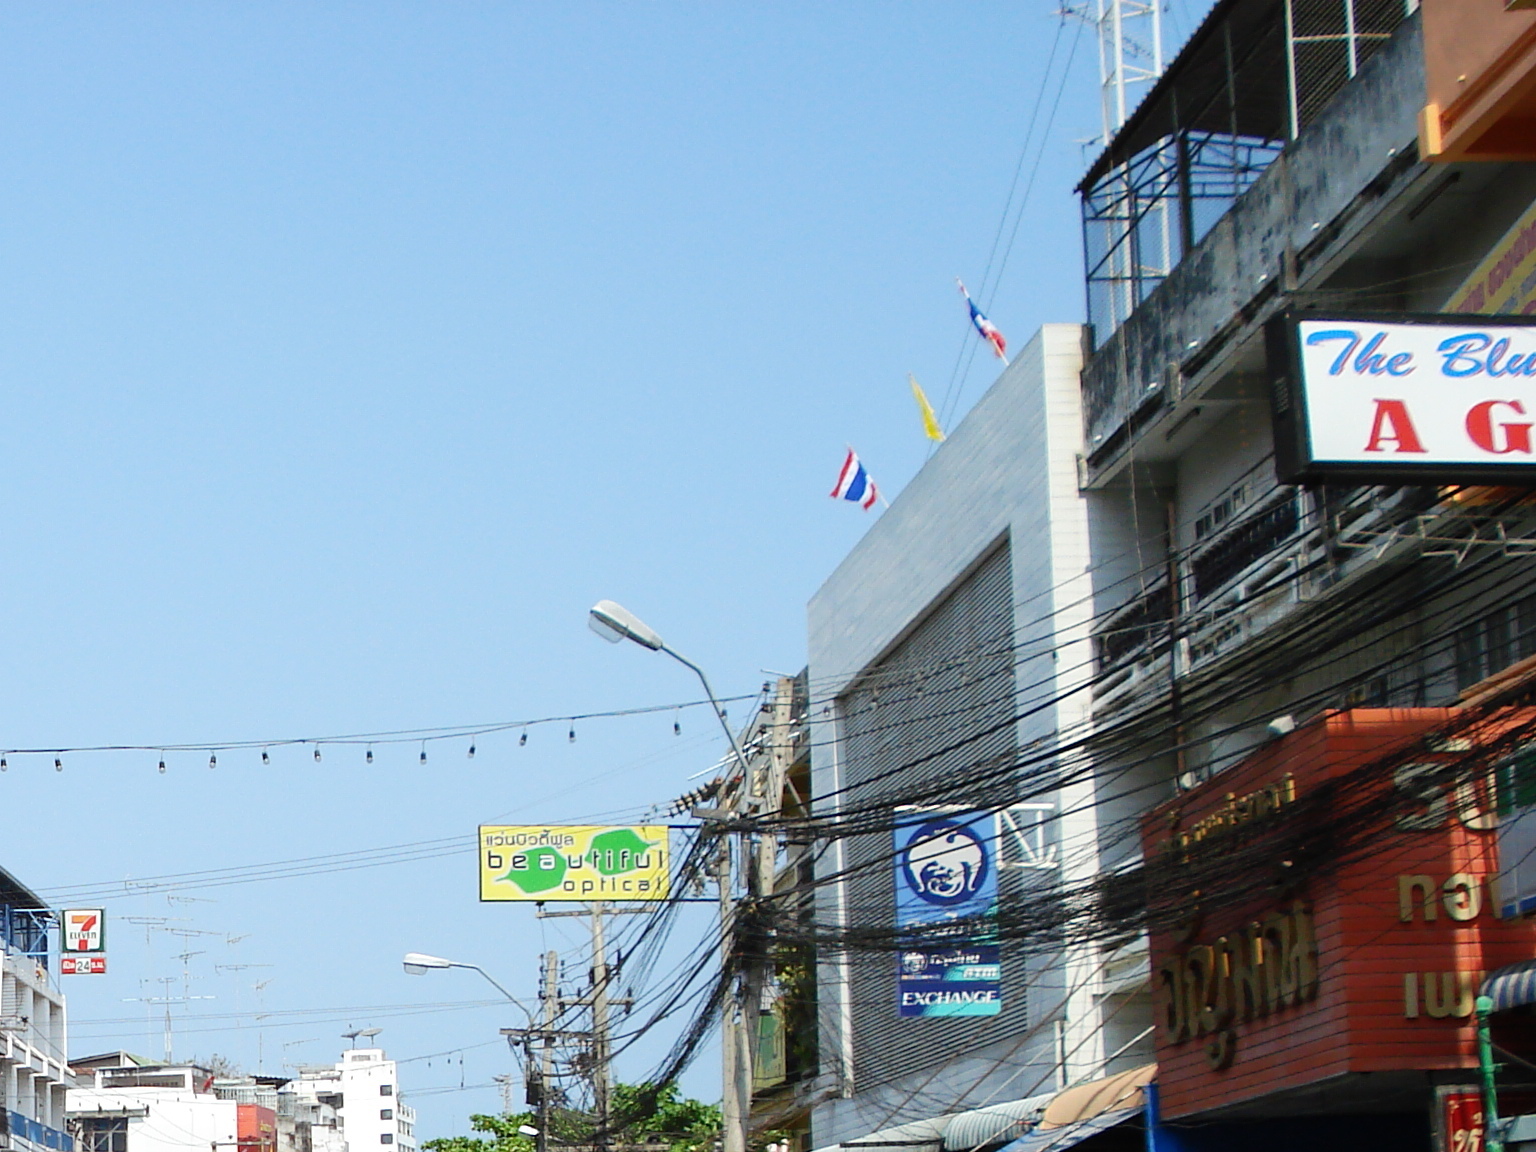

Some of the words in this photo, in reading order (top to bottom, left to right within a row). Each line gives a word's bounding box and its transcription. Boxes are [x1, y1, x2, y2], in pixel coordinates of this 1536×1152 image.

[1305, 329, 1417, 377] The
[1363, 398, 1429, 454] A
[488, 849, 663, 869] beautiful
[563, 877, 662, 895] optical
[76, 960, 90, 972] 24
[901, 990, 998, 1006] EXCHANGE
